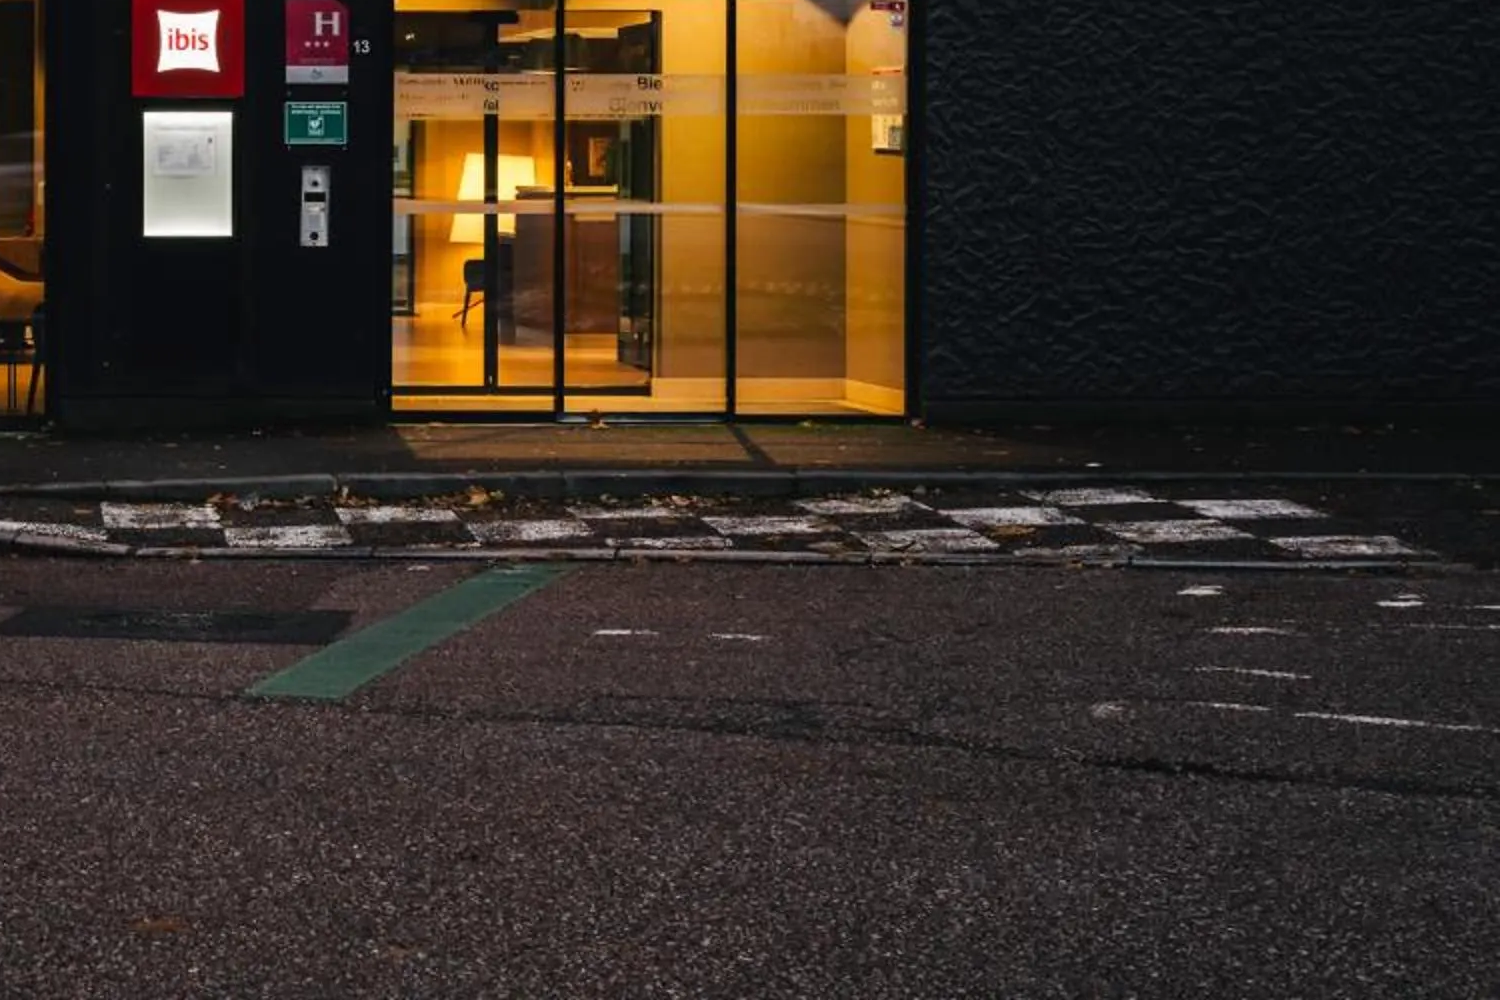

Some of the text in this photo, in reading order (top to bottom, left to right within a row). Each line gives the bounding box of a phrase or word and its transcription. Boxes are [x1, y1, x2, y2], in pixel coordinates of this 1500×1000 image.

[314, 11, 340, 36] H
[167, 27, 209, 51] ibis
[353, 40, 371, 53] 13
